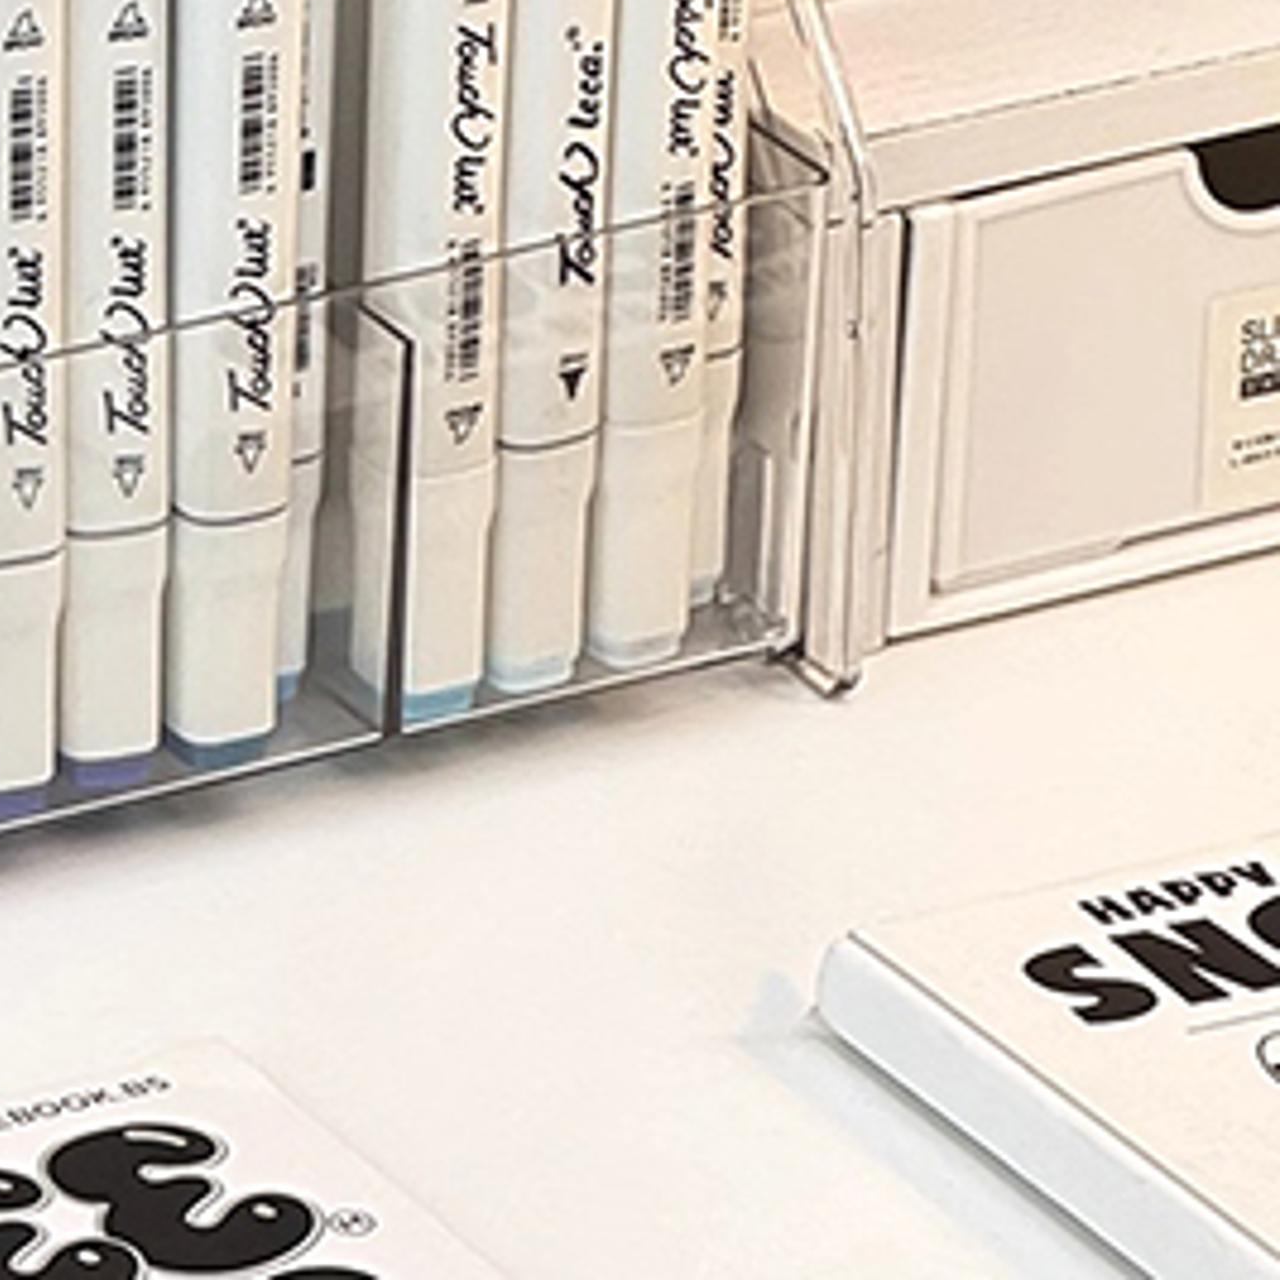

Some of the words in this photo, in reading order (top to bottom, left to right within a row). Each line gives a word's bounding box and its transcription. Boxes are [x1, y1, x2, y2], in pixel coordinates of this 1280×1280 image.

[446, 20, 500, 150] Touch
[556, 138, 605, 290] Touch
[100, 297, 152, 436] Touch
[228, 282, 276, 414] Touch
[1078, 859, 1276, 926] HAPPY
